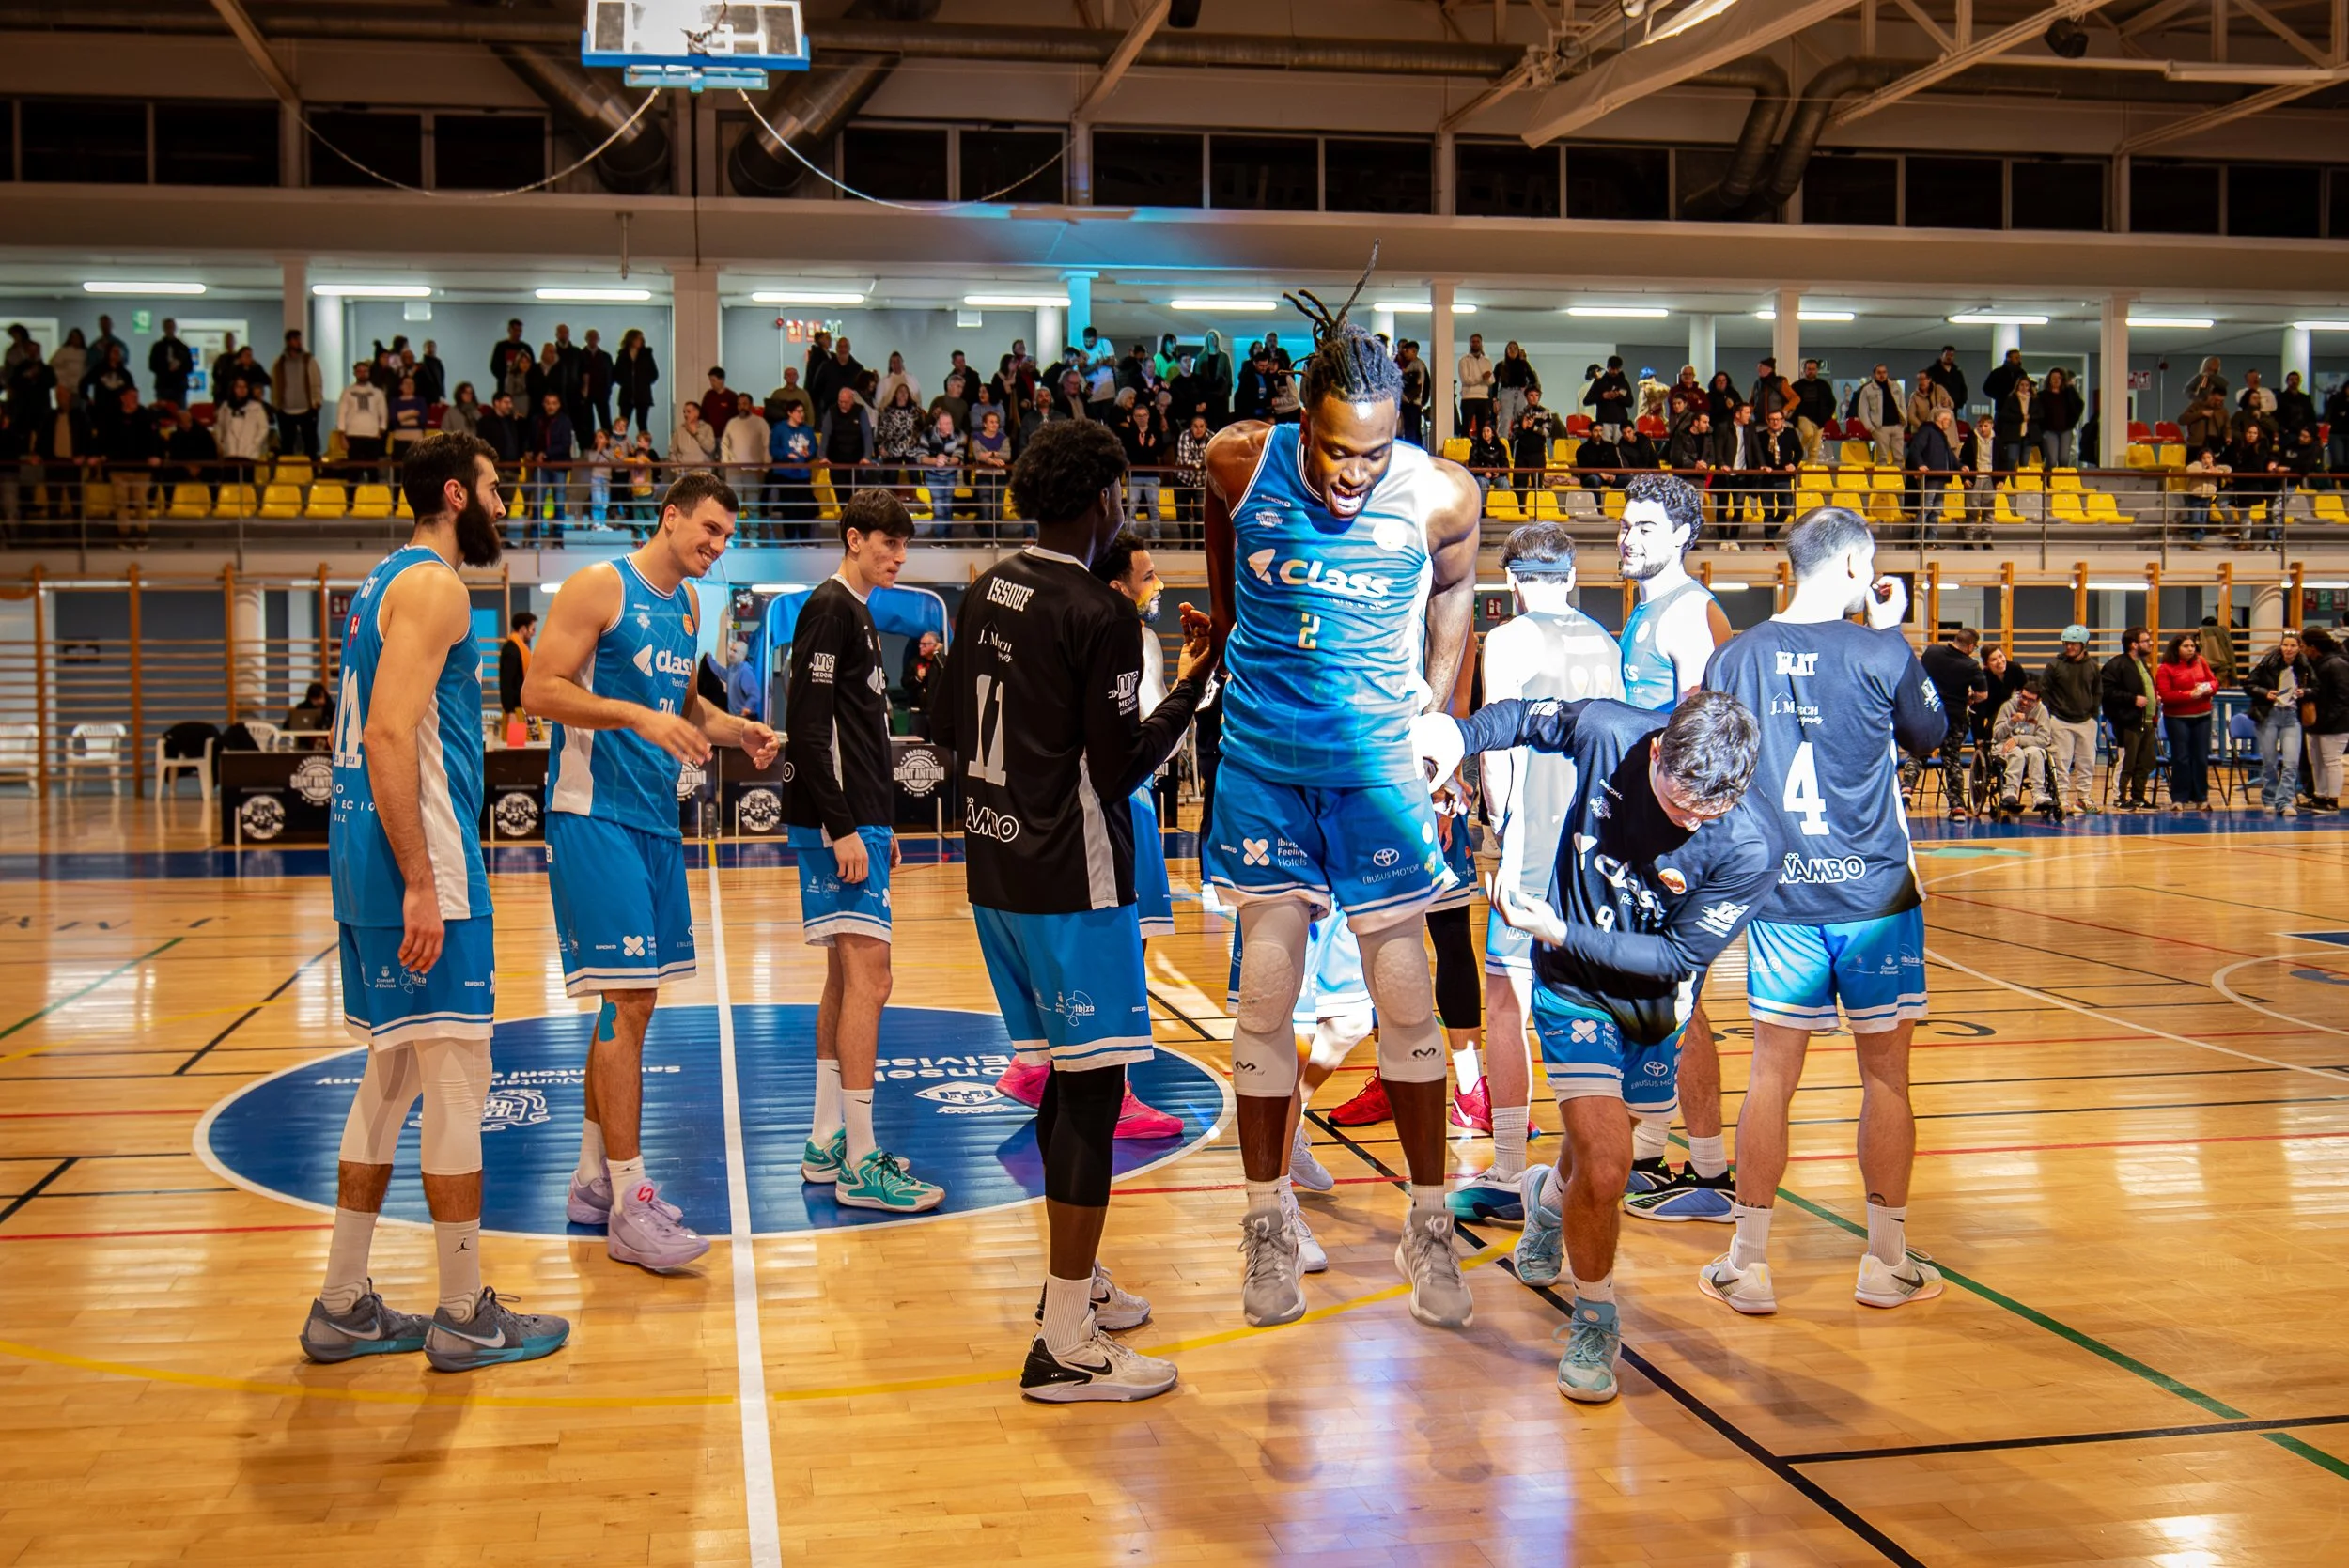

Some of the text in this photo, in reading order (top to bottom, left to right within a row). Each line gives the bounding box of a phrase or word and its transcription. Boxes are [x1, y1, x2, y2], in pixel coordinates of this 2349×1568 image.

[987, 577, 1034, 612] ISSOUF
[1298, 613, 1320, 649] 2
[968, 674, 1006, 786] 11
[1783, 741, 1830, 835] 4
[1392, 863, 1420, 877] MOTOR
[1595, 905, 1615, 933] 9
[1075, 1003, 1095, 1013] Ibiza
[874, 1067, 1006, 1082] onsel
[875, 1055, 1010, 1068] Eiviss
